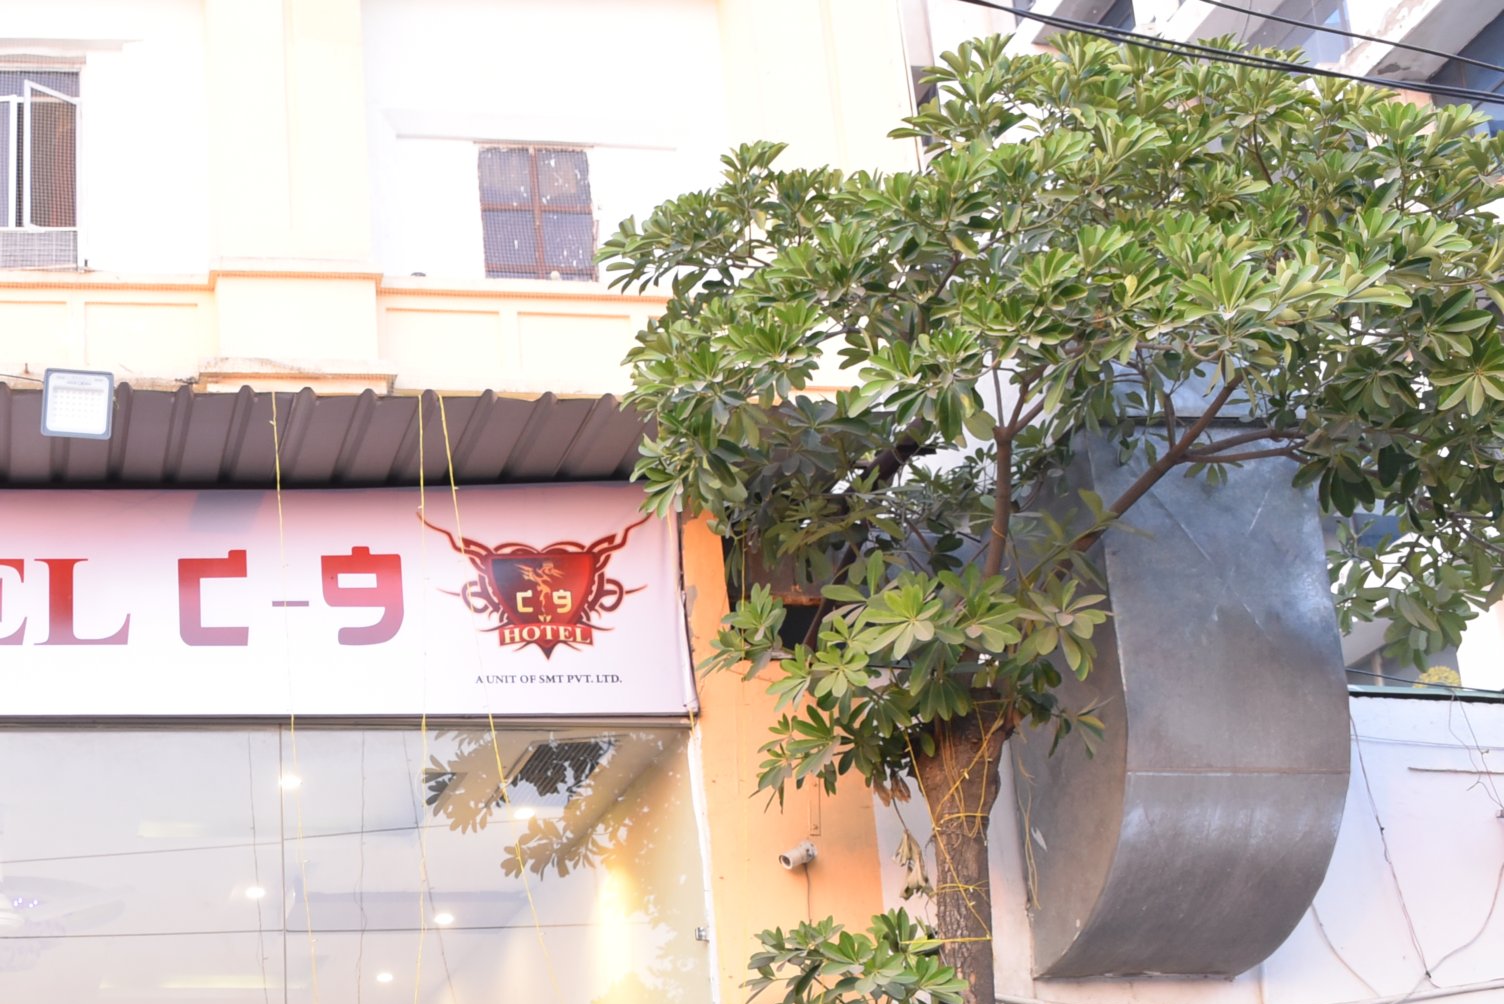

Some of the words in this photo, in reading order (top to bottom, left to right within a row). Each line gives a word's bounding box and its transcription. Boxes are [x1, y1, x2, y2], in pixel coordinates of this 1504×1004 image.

[177, 545, 405, 647] C-9
[516, 589, 534, 613] C
[552, 589, 572, 614] 9
[503, 624, 591, 645] HOTEL
[475, 675, 484, 684] A
[486, 675, 517, 684] UNIT
[519, 675, 536, 684] OF
[538, 674, 564, 684] SMT
[567, 674, 594, 684] PVT.
[596, 674, 623, 684] LTD.
